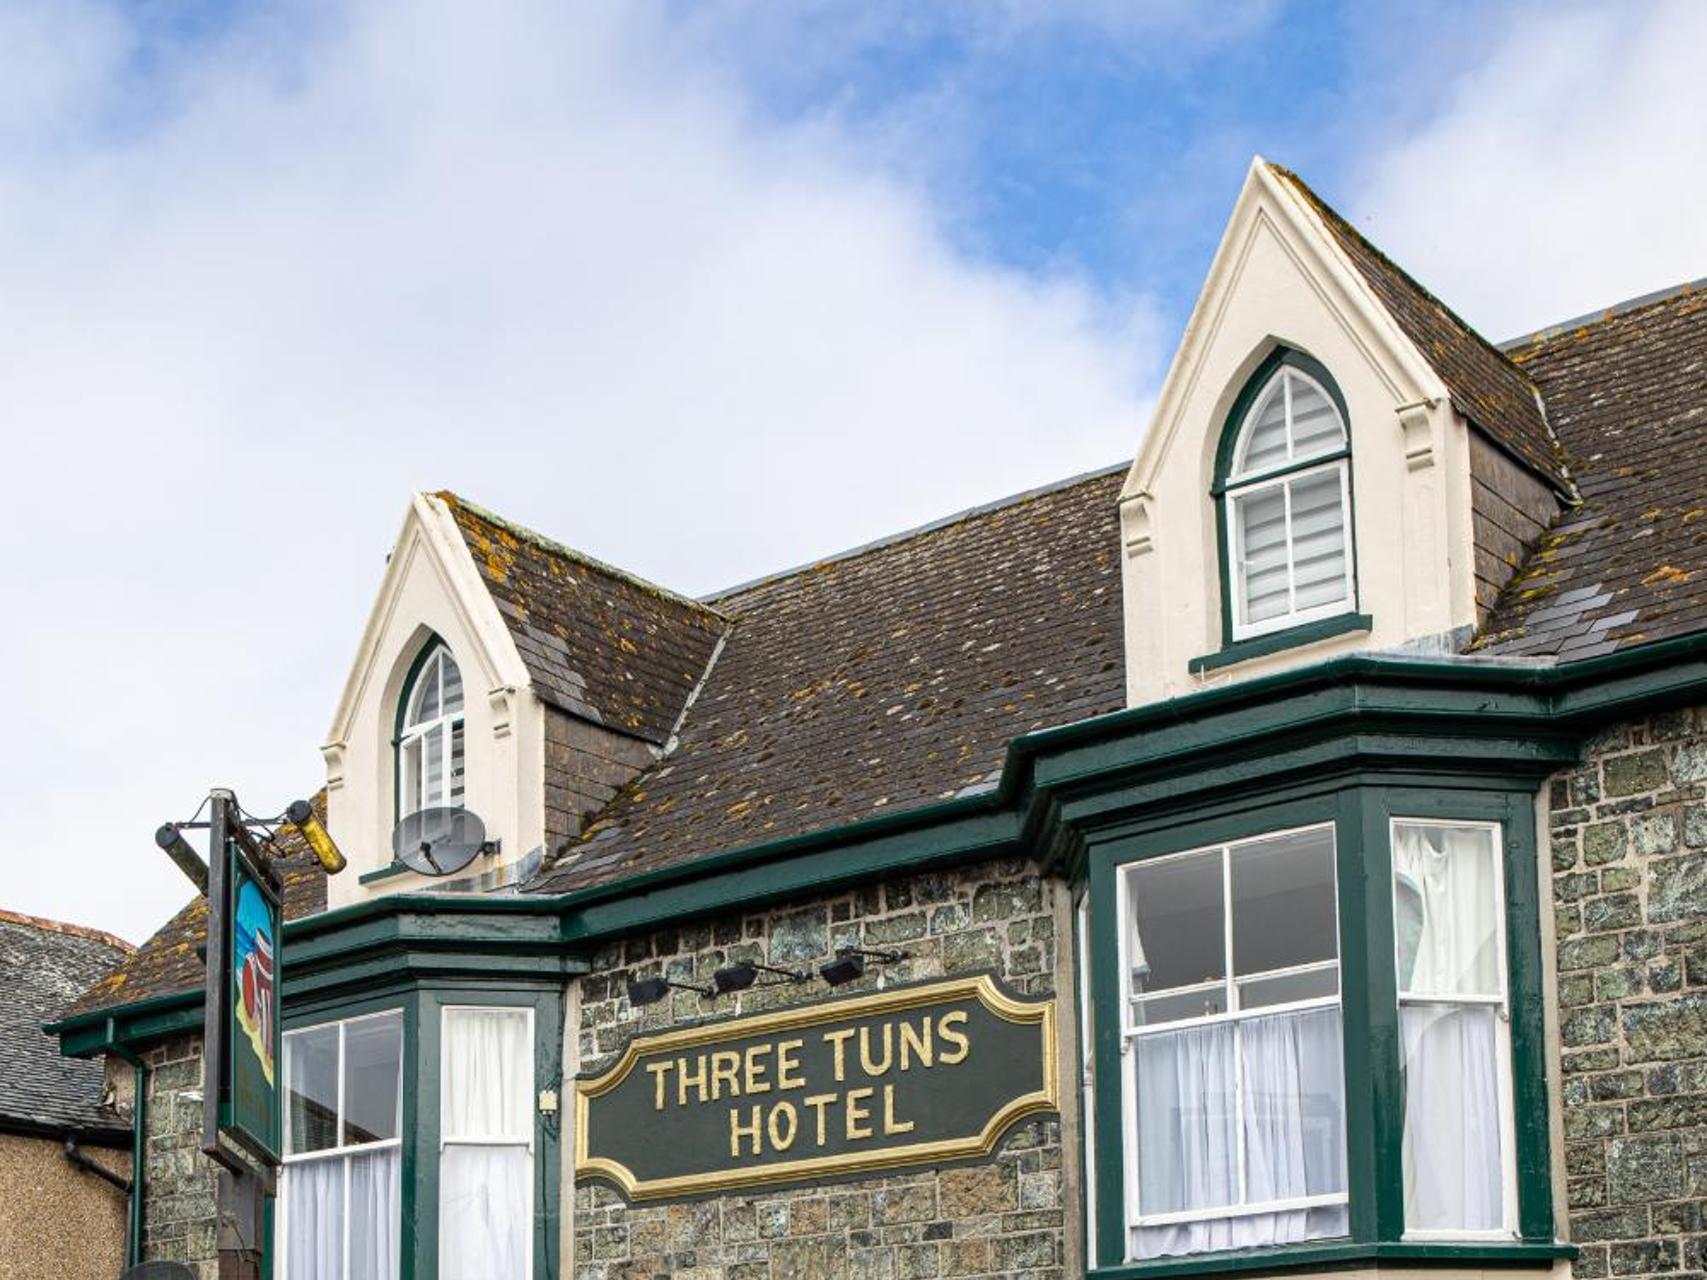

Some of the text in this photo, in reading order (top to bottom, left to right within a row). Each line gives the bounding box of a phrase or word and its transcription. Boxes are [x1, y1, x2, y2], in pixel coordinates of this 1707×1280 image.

[646, 1010, 971, 1111] THREE TUNS
[729, 1084, 915, 1157] HOTEL
